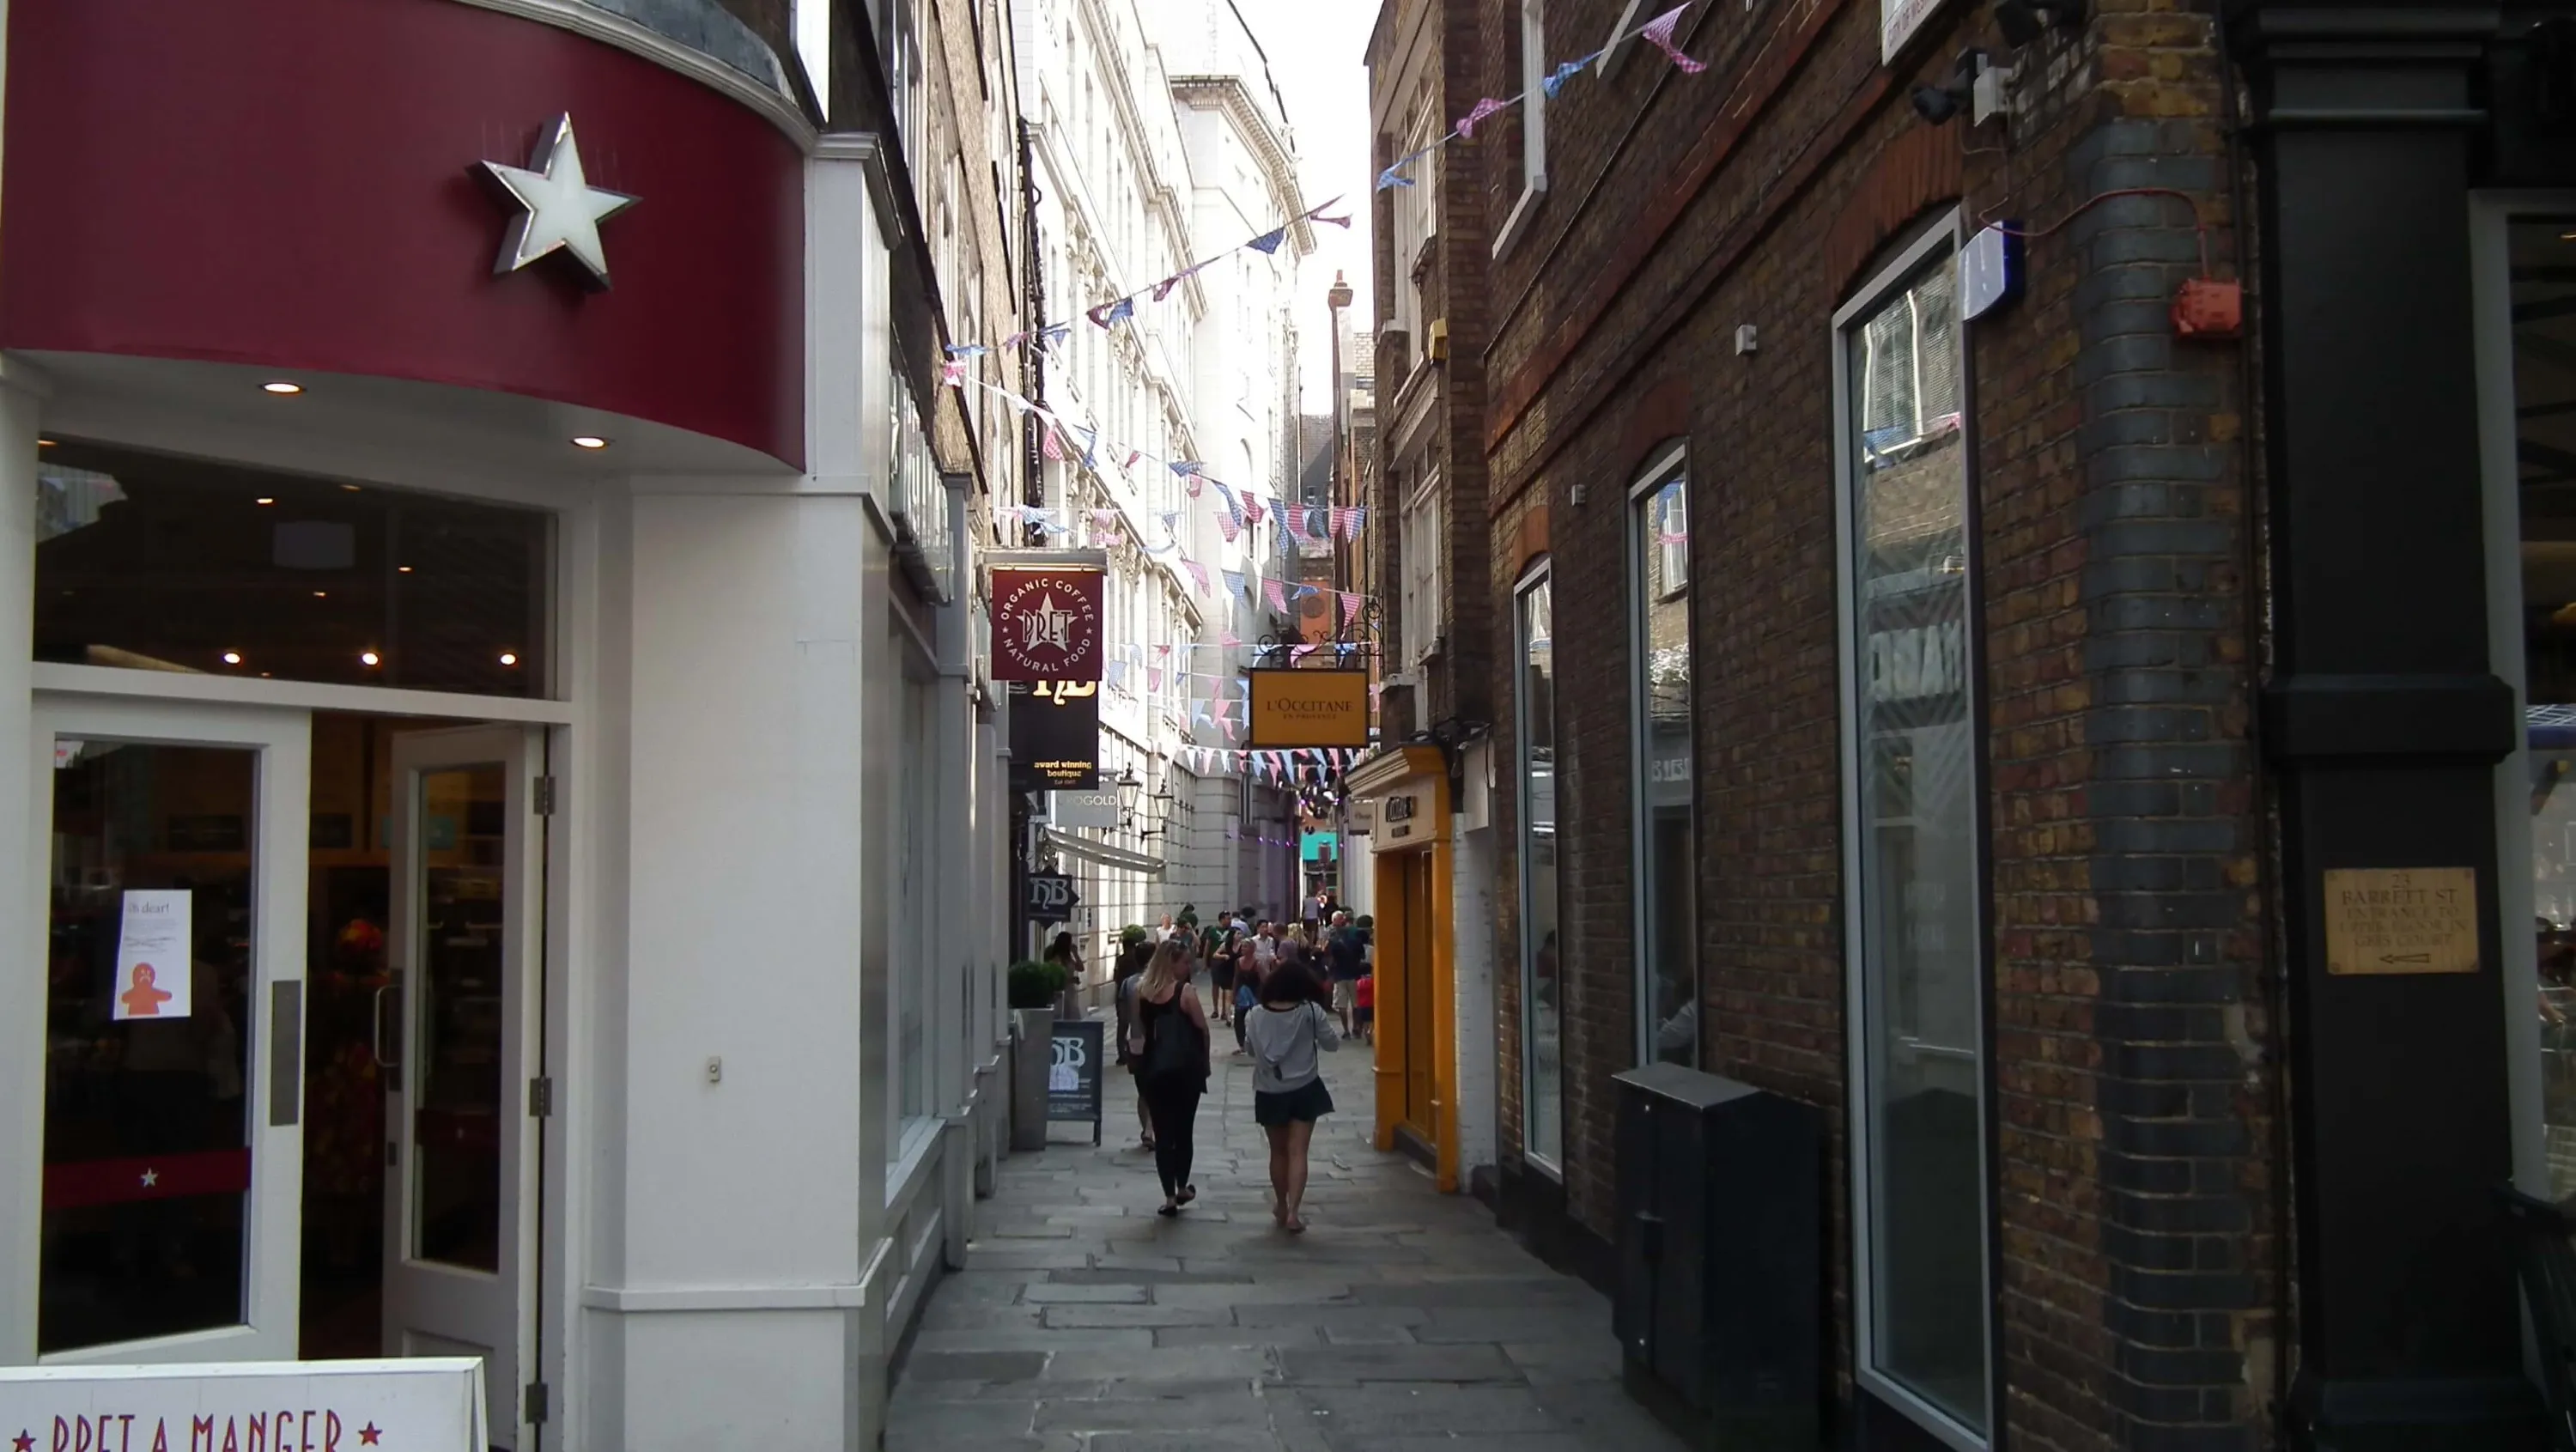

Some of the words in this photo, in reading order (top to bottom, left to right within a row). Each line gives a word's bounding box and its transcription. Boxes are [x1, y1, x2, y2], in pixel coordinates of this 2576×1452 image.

[1000, 578, 1048, 620] ORGANIC
[1055, 580, 1094, 622] COFFEE
[1023, 609, 1072, 643] PRET
[1003, 638, 1059, 672] NATURAL
[1063, 639, 1091, 666] FOOD
[1267, 697, 1354, 712] L'OCCITANE
[1034, 760, 1060, 769] award
[1060, 761, 1092, 769] winning
[1047, 769, 1082, 778] boutique
[2342, 889, 2428, 905] BARRETT
